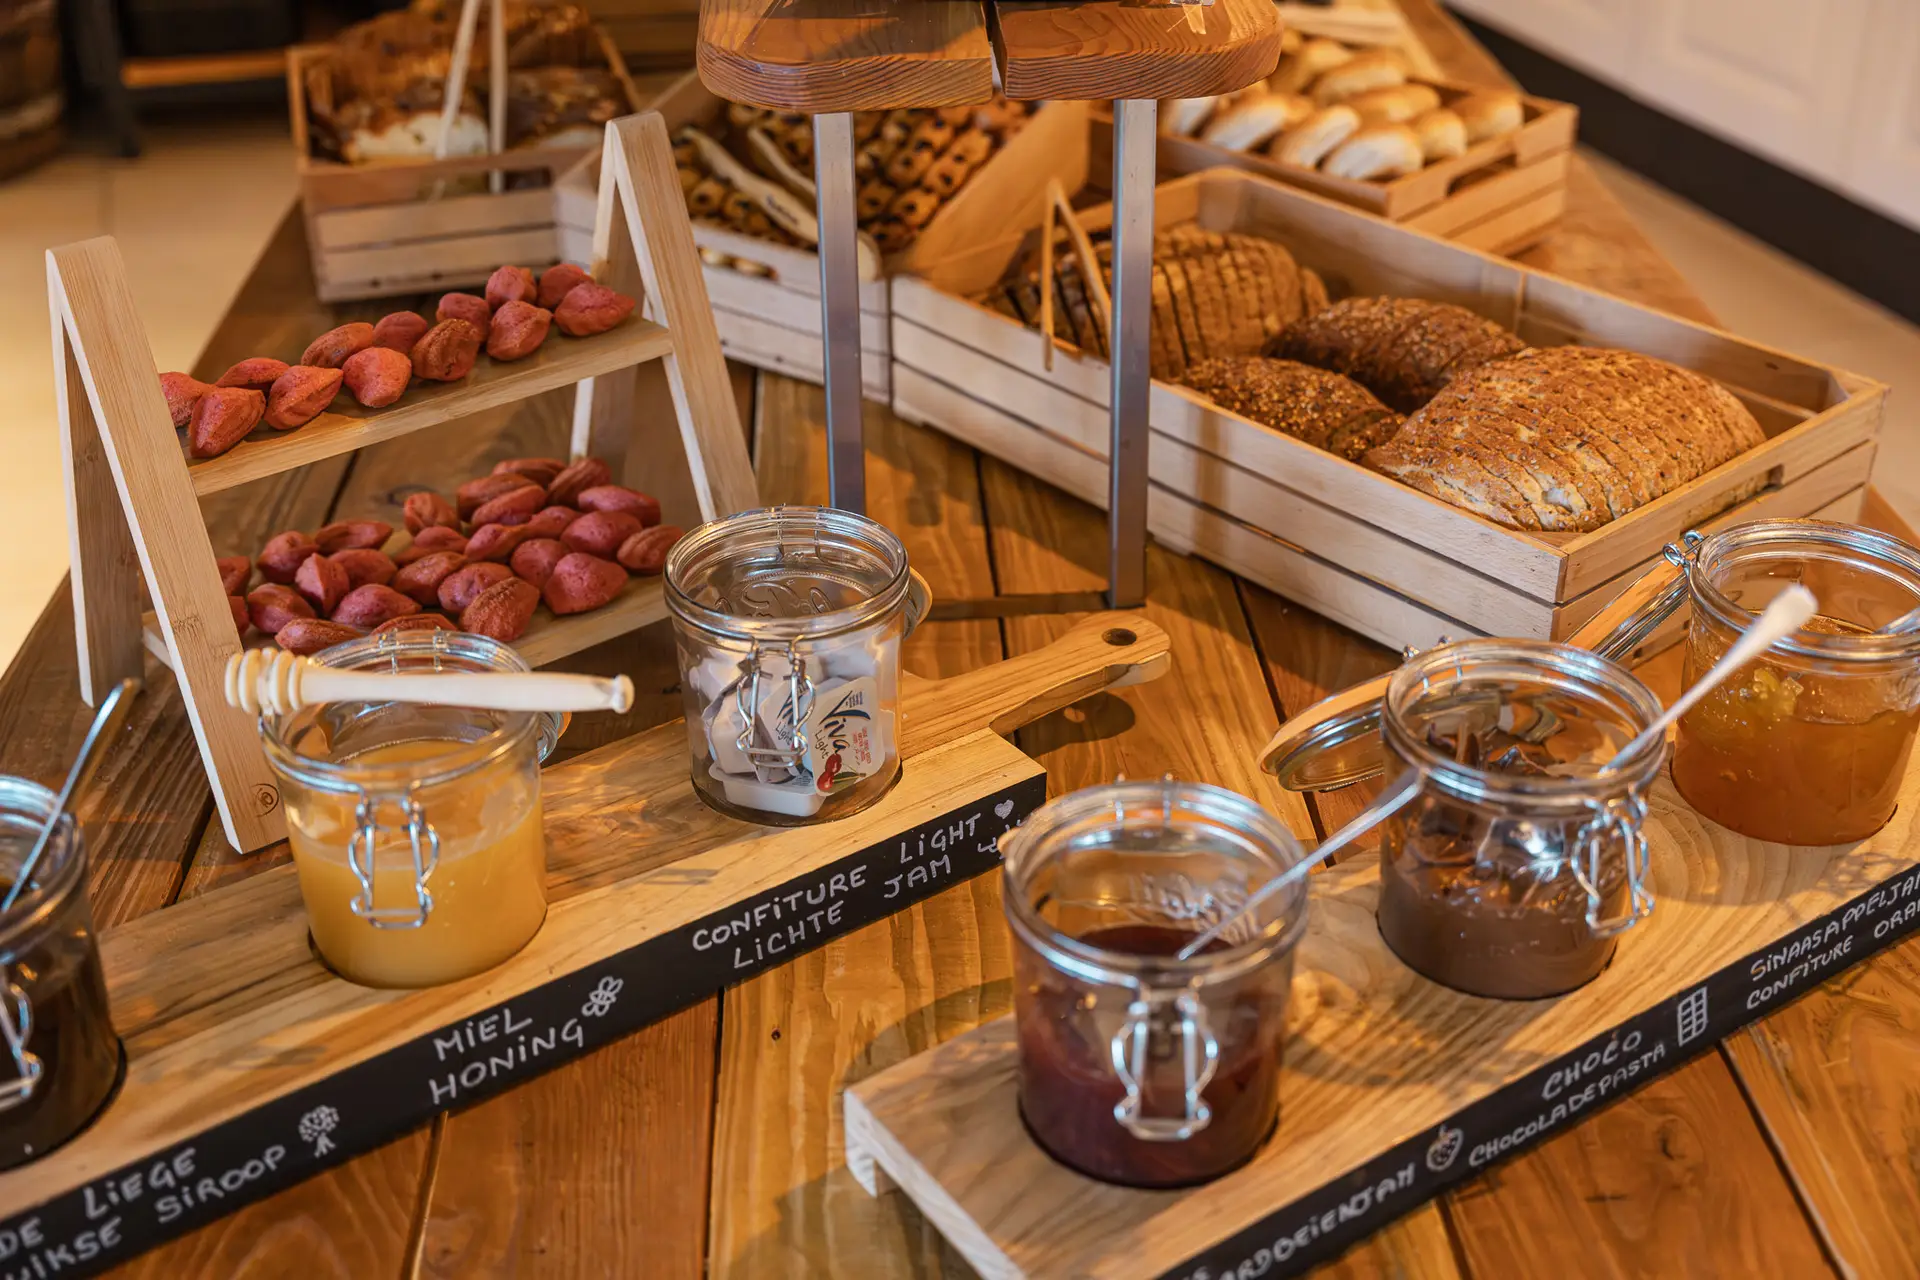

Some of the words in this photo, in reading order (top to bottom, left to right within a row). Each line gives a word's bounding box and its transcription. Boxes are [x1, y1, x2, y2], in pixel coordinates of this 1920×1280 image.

[814, 729, 830, 760] Light
[818, 690, 872, 754] Viva
[883, 855, 951, 899] JAM
[429, 1018, 584, 1105] HONiNG
[433, 1008, 533, 1061] MiEL
[1541, 1029, 1643, 1101] CHOCO
[1468, 1042, 1666, 1168] CHOCOLADEPASTA
[0, 1216, 45, 1258] DE
[83, 1147, 197, 1220] LiEGE
